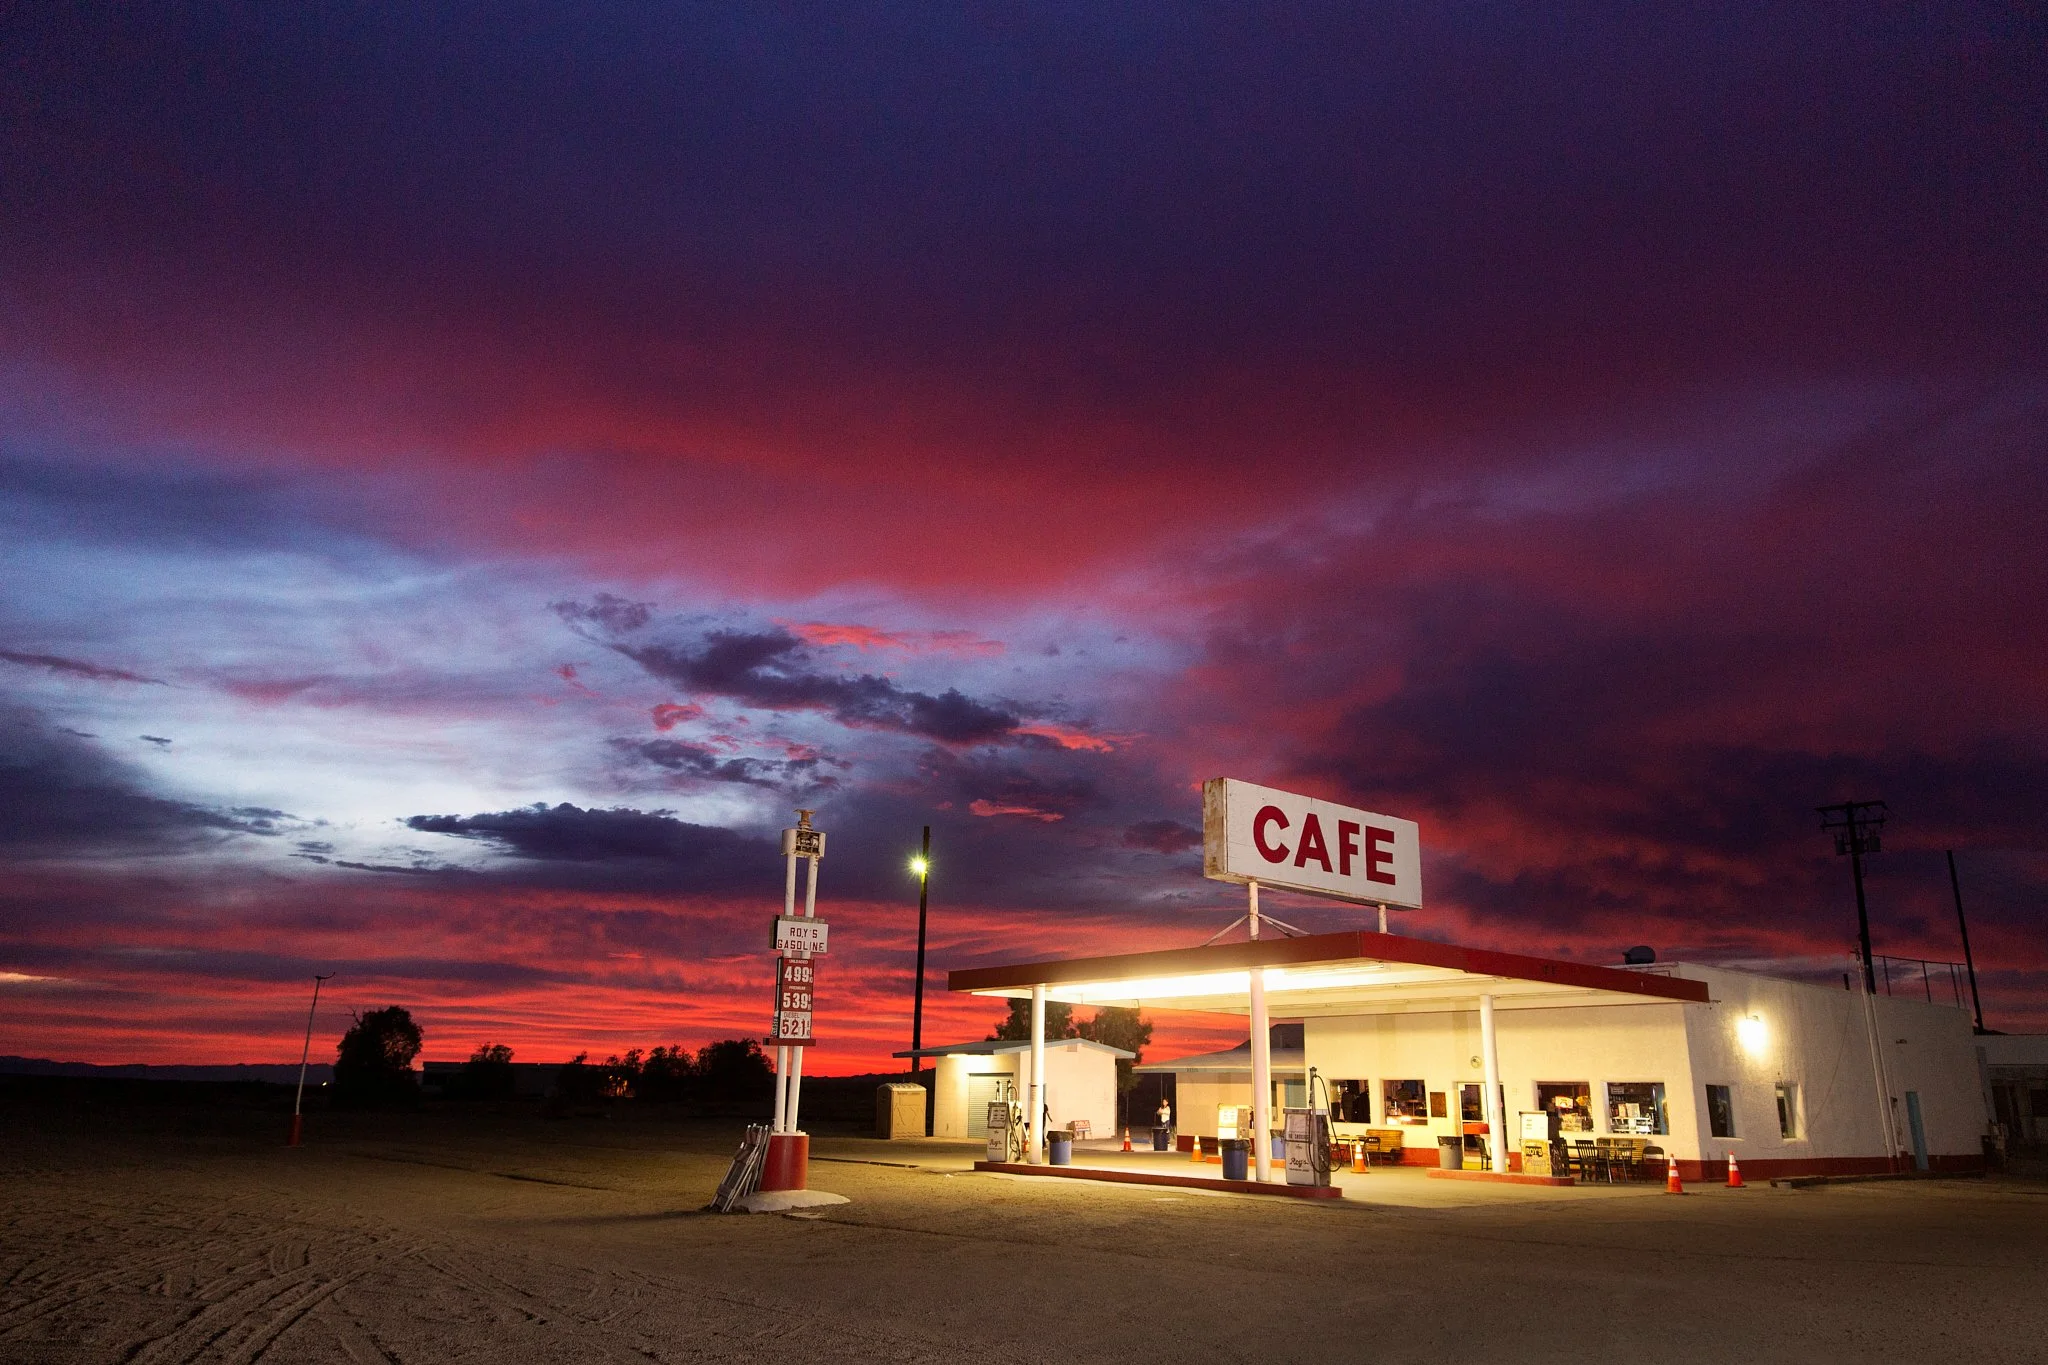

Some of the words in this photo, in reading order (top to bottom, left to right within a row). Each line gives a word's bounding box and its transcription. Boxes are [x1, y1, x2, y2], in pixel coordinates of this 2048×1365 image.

[1253, 805, 1396, 885] CAFE
[790, 927, 818, 939] ROY'S
[777, 939, 825, 952] GASOLINE
[784, 966, 810, 983] 499
[782, 992, 809, 1009] 539
[781, 1019, 806, 1036] 521
